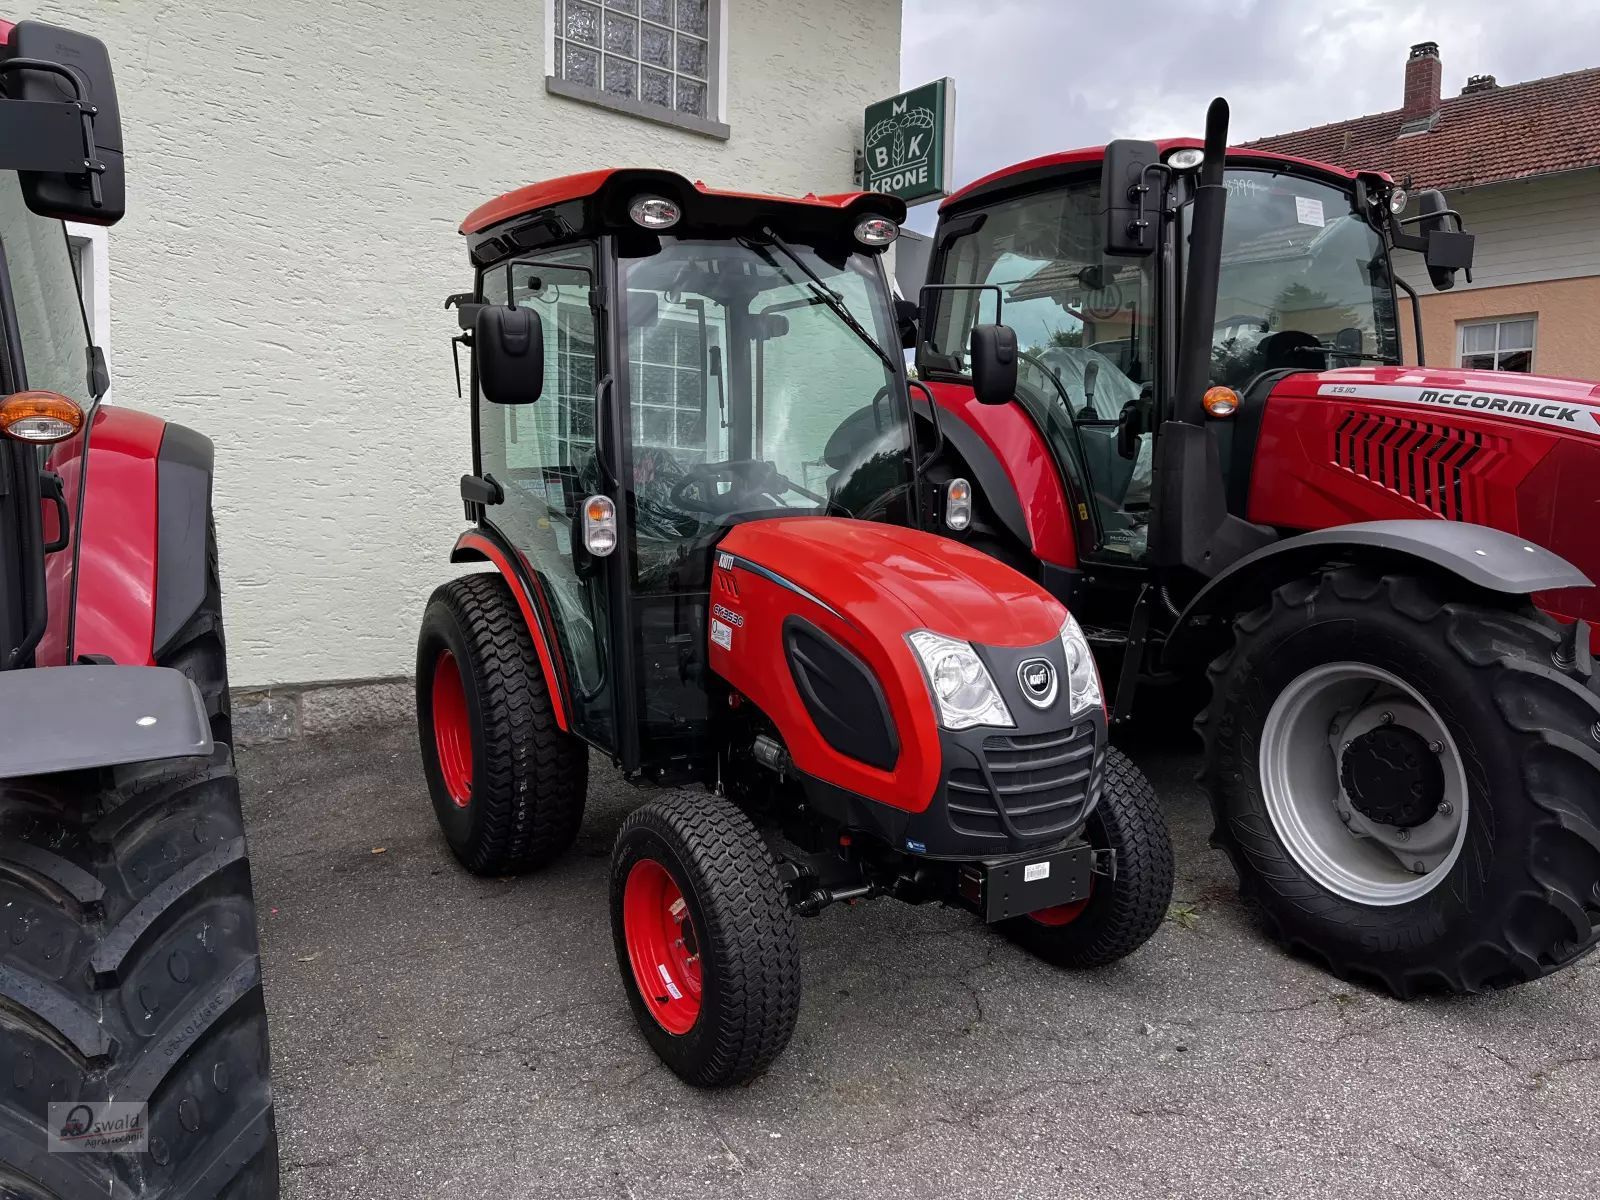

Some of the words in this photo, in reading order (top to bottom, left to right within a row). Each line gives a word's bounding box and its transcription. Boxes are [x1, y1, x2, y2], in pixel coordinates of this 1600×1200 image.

[892, 96, 908, 116] M
[875, 146, 889, 168] B
[907, 133, 924, 159] K
[869, 166, 928, 194] KRONE
[1417, 389, 1581, 423] McCORMICK
